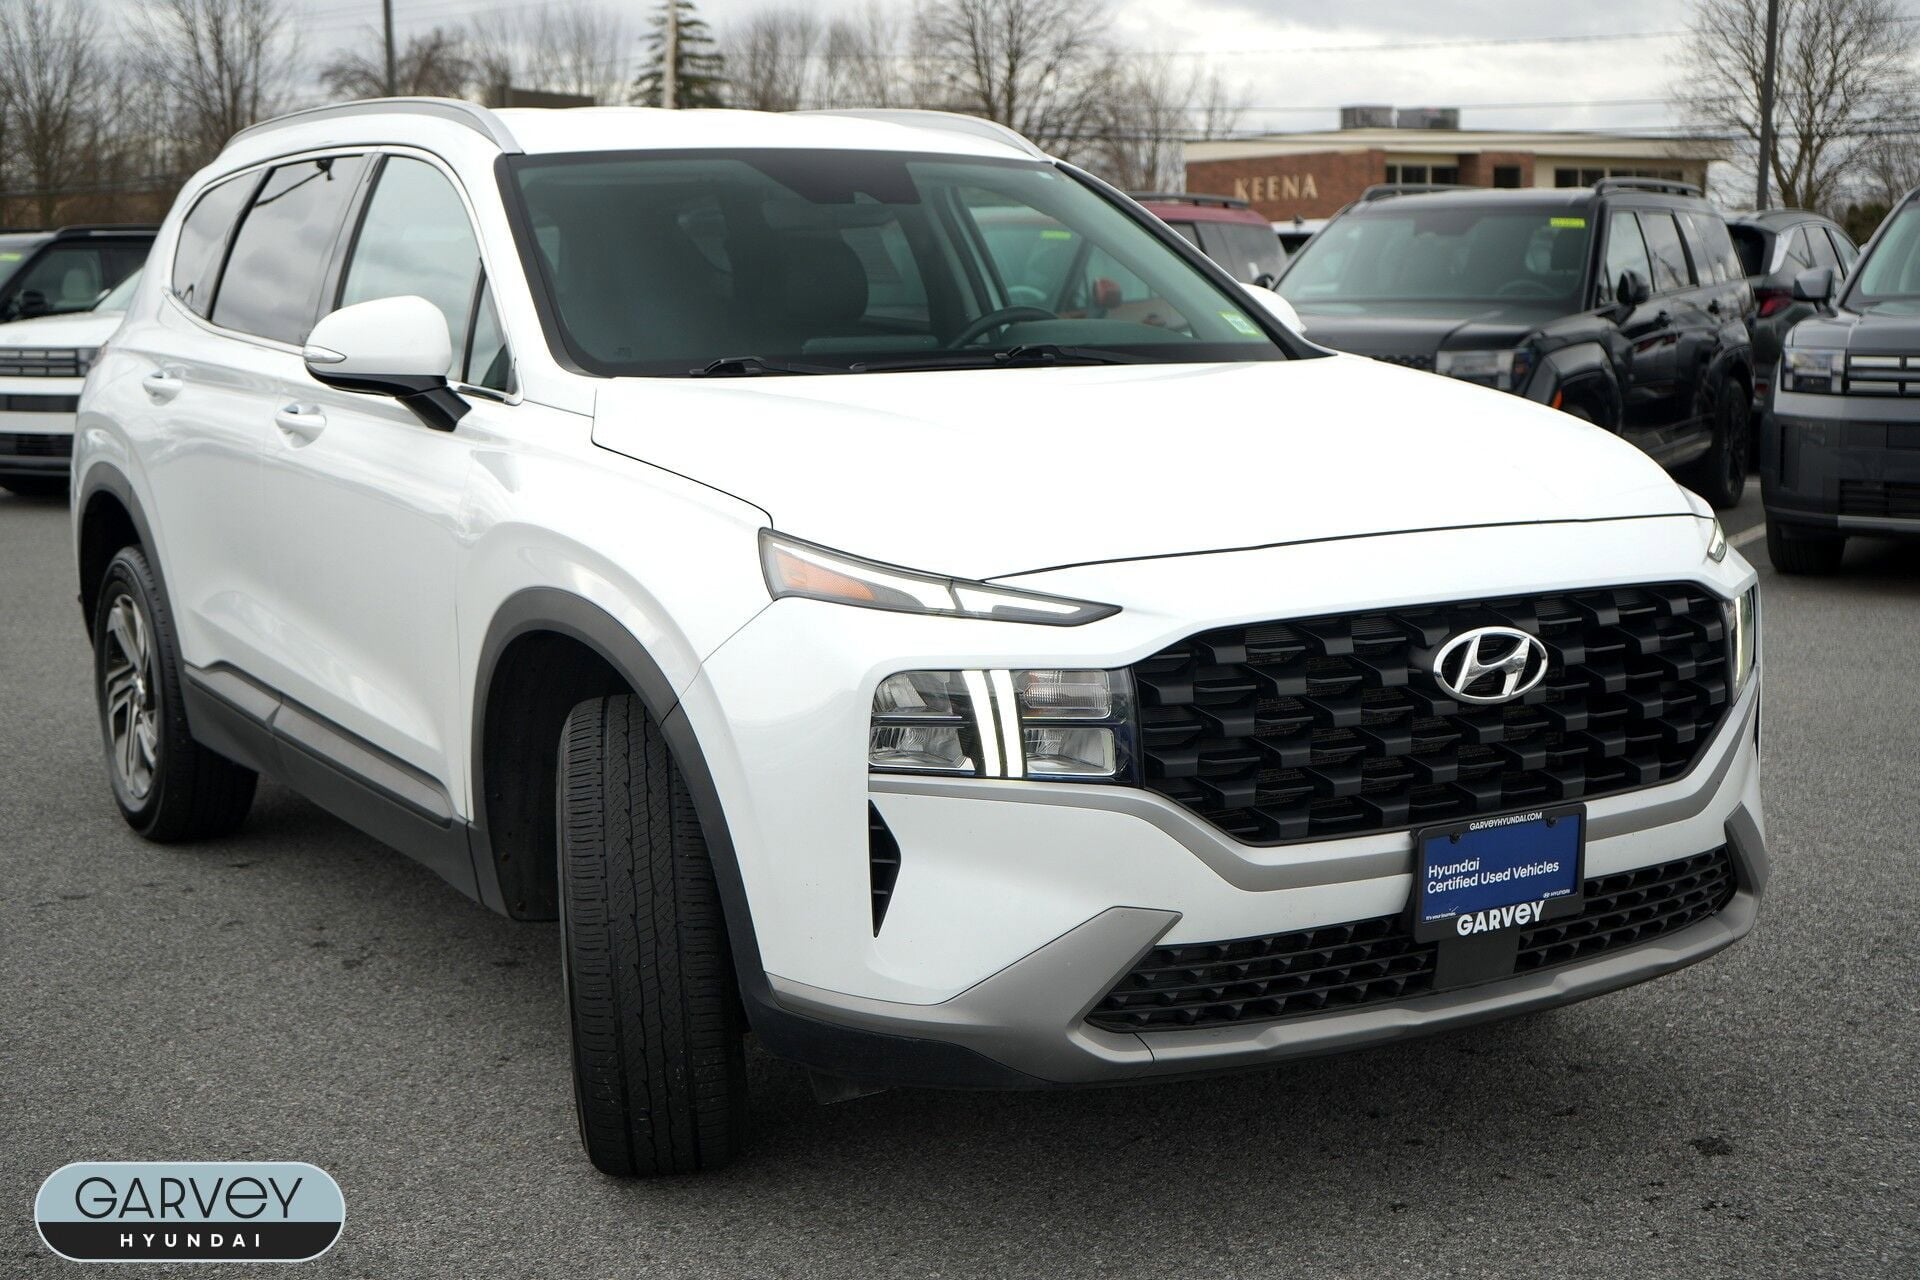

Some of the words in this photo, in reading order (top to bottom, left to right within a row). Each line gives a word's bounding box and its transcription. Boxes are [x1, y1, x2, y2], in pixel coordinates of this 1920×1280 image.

[1233, 172, 1319, 201] KEENA
[1427, 872, 1478, 894] Certified
[1481, 868, 1511, 884] Used
[1513, 860, 1560, 879] Vehicles
[1428, 857, 1480, 880] Hyundai
